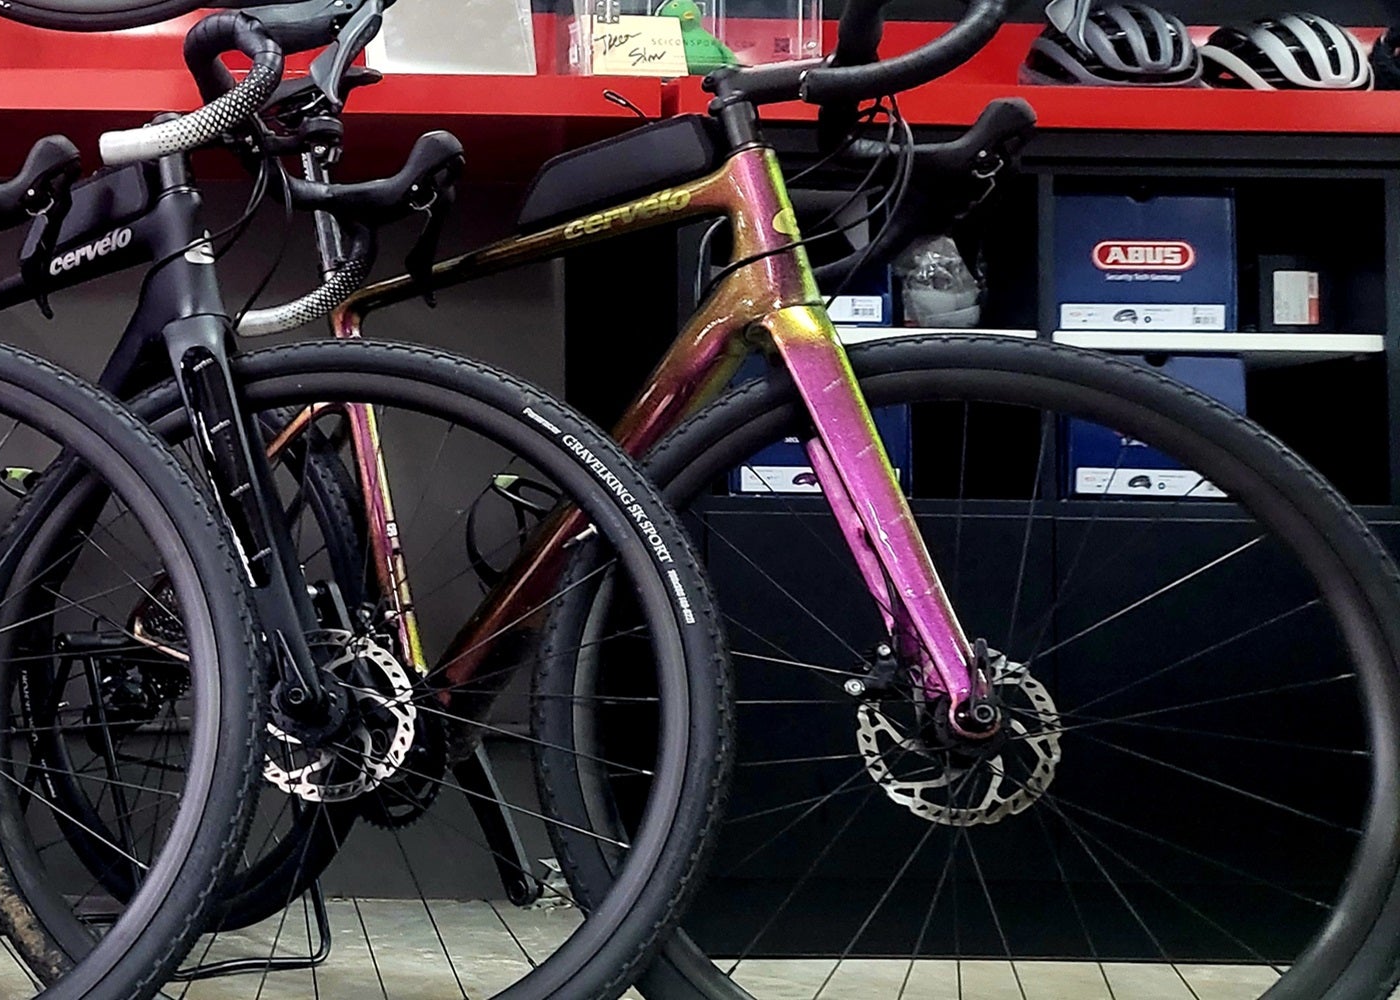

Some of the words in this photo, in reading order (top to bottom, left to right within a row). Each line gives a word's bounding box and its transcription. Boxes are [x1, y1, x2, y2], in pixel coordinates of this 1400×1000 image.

[564, 188, 691, 239] cervélo
[49, 227, 133, 276] cervélo
[1105, 246, 1182, 264] ABUS
[562, 434, 636, 506] GRAVELKING
[627, 503, 648, 524] SK
[638, 520, 674, 564] SPORT
